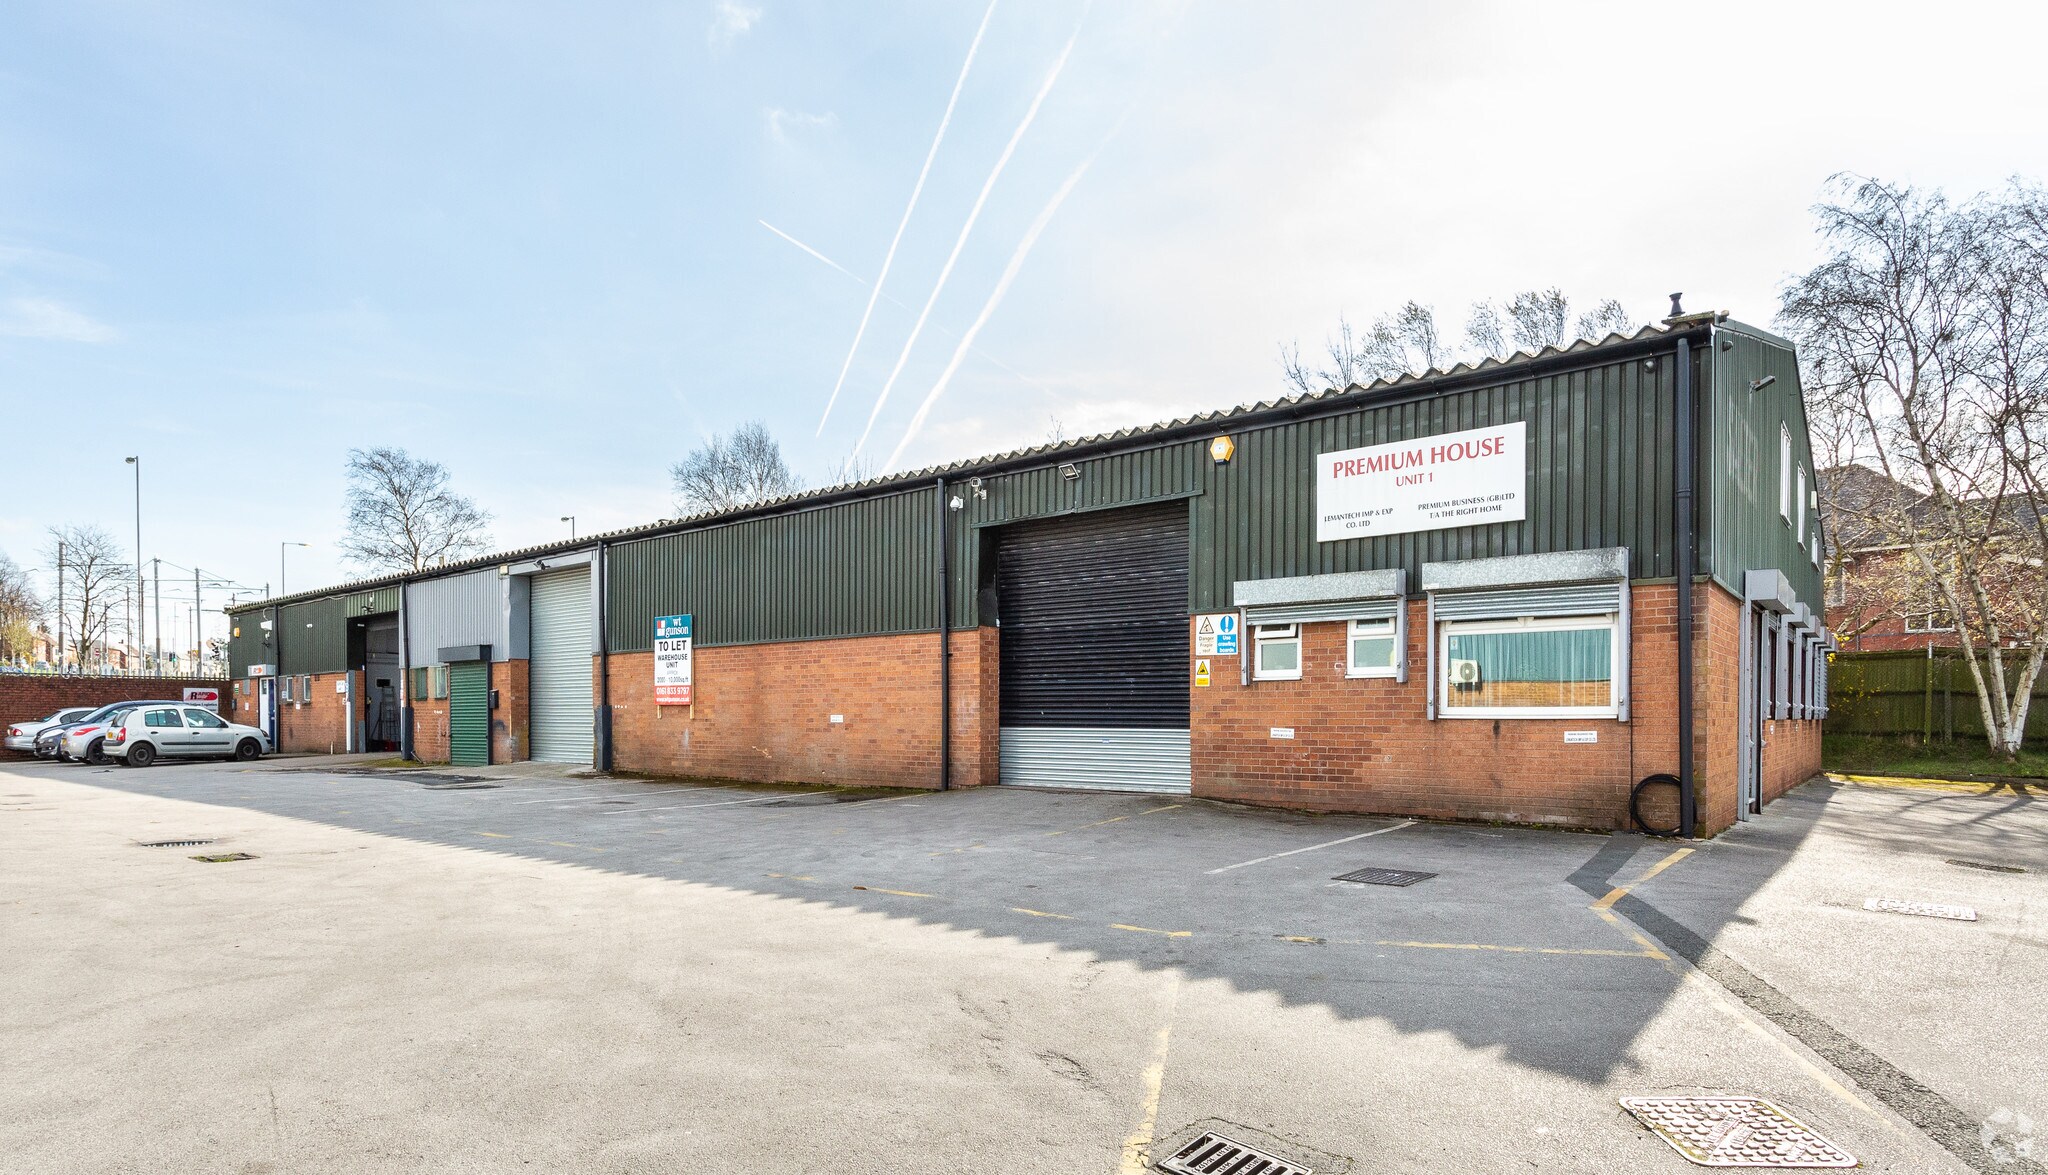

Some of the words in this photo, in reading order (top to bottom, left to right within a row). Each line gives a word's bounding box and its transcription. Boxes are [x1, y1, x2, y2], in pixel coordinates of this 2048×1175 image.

[1333, 448, 1423, 479] PREMIUM
[1430, 436, 1505, 464] HOUSE
[1396, 473, 1425, 487] UNIT
[1428, 472, 1433, 483] 1
[1418, 500, 1450, 511] PREMIUM
[1451, 496, 1485, 507] BUSINESS
[1324, 512, 1361, 523] LEMANTECH
[1361, 510, 1374, 519] IMP
[1381, 508, 1394, 516] EXP
[1441, 509, 1455, 518] THE
[1456, 507, 1479, 516] RIGHT
[1480, 504, 1503, 514] HOME
[1346, 521, 1358, 529] CO.
[1359, 520, 1371, 528] LTD
[672, 617, 682, 627] wt
[665, 626, 689, 638] gunson
[658, 641, 669, 652] TO
[671, 640, 687, 651] LET
[657, 653, 688, 661] WAREHOUSE
[667, 687, 677, 695] 833
[677, 686, 690, 695] 9797
